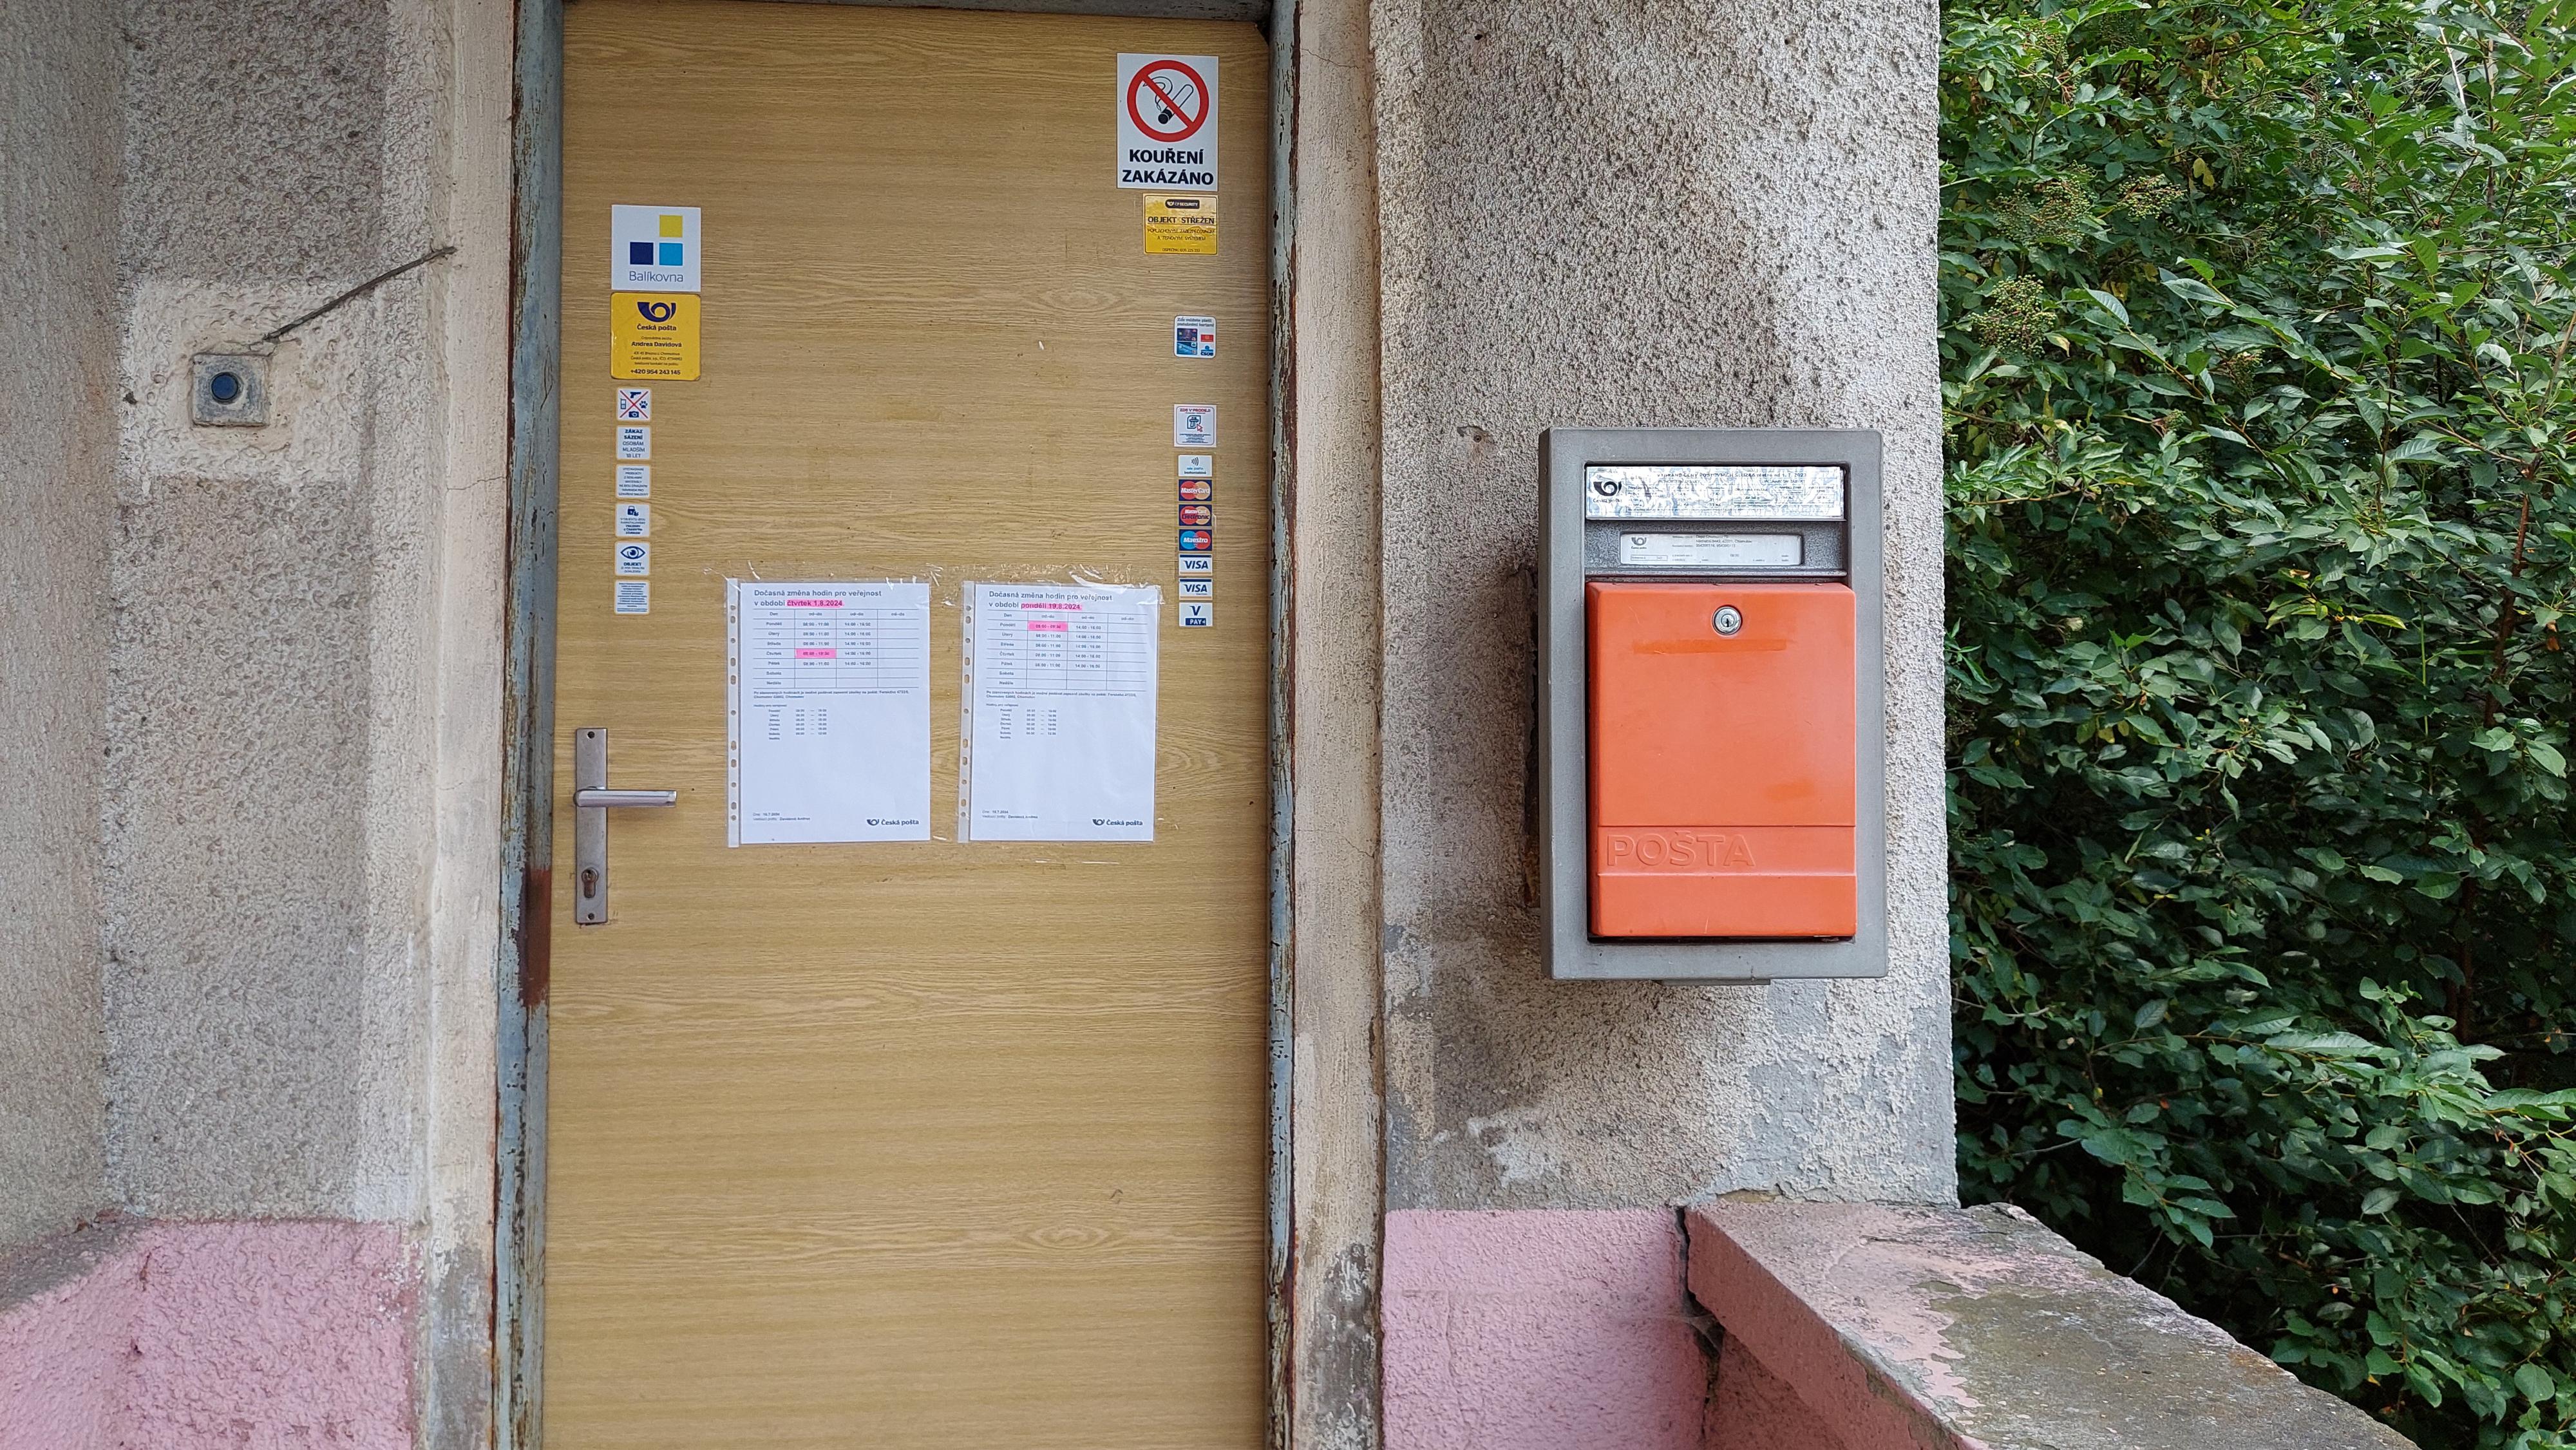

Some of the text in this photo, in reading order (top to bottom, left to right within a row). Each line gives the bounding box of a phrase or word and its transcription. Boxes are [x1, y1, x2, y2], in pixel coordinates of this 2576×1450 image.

[1129, 148, 1204, 165] KOUŘENÍ
[1122, 169, 1214, 185] ZAKÁZÁNO
[1181, 216, 1214, 224] STŘEŽEN
[629, 270, 683, 282] Balíkovna
[1184, 560, 1209, 569] VISA
[1184, 584, 1208, 592] VISA
[1190, 605, 1201, 616] V
[1607, 830, 1756, 867] POŠTA
